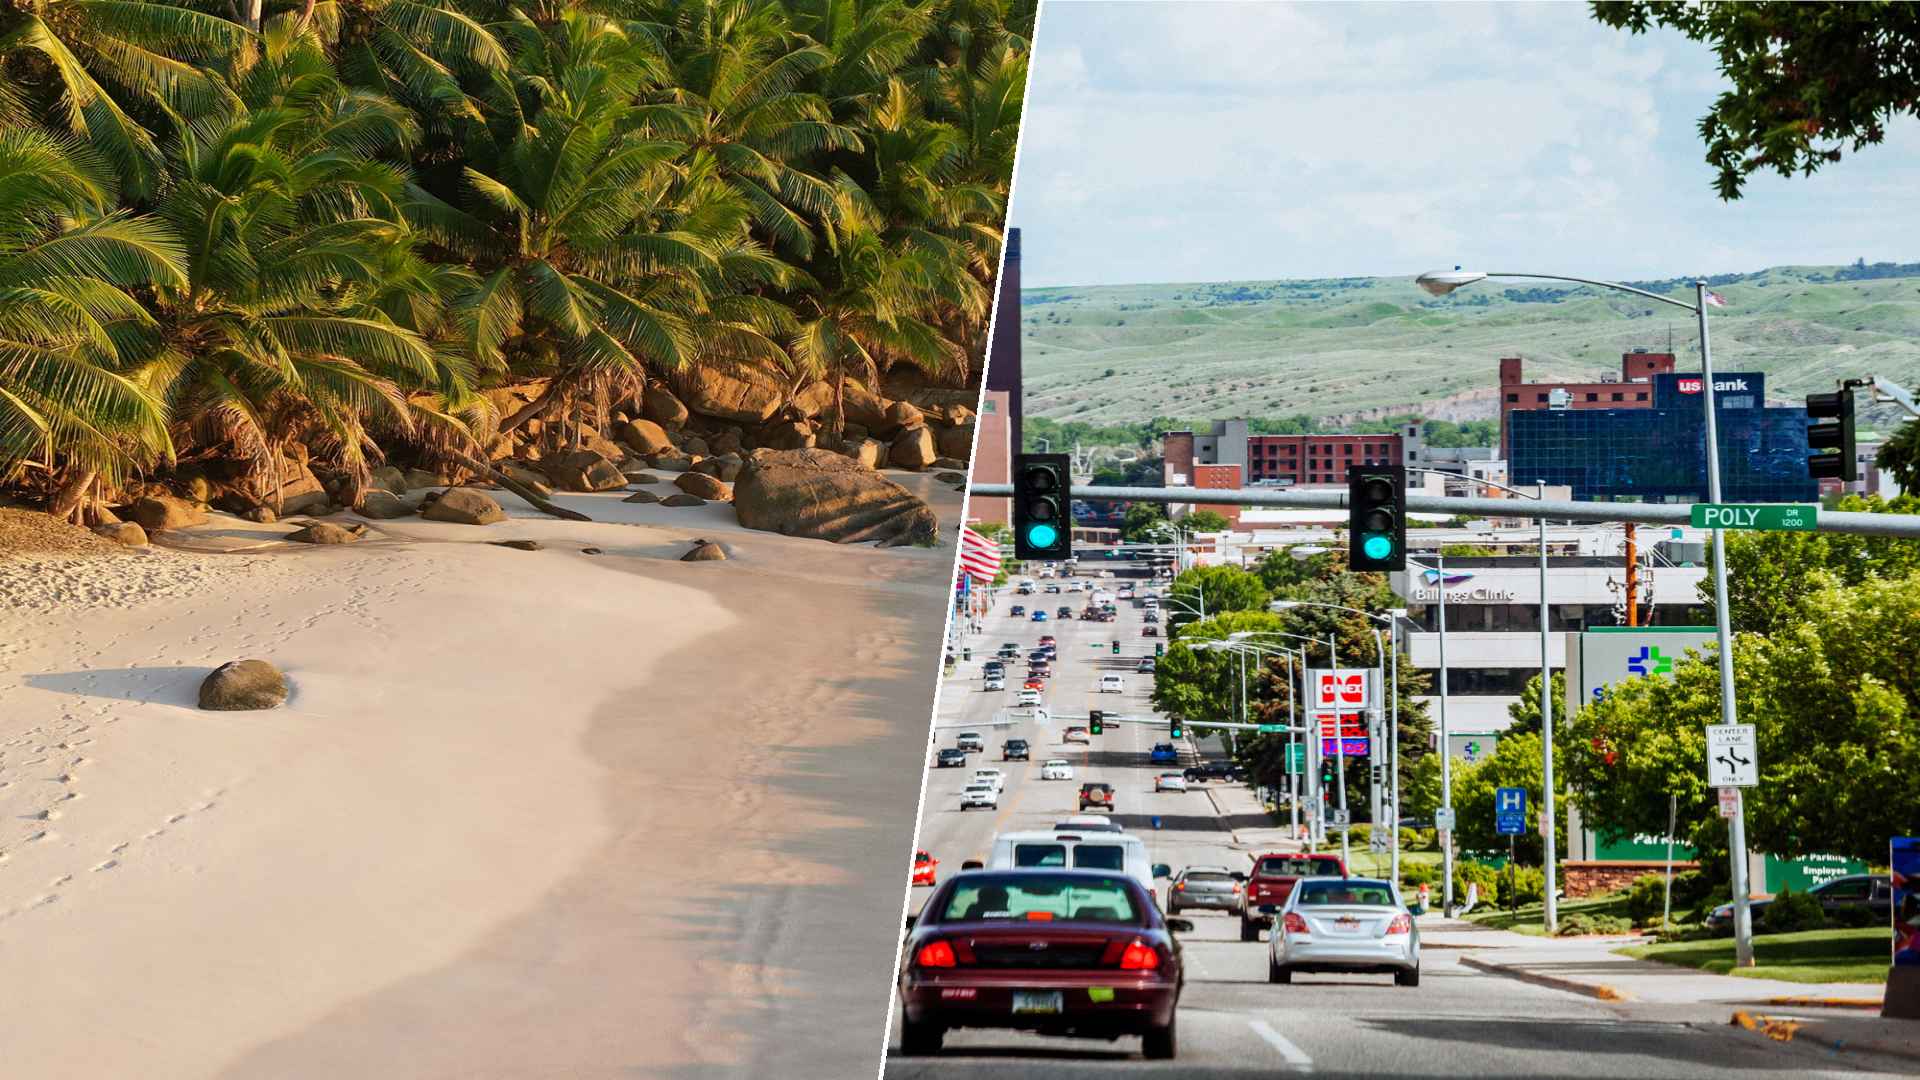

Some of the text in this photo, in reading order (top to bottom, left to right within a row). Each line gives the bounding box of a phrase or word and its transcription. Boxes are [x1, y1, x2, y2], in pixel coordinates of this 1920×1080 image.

[1705, 508, 1760, 526] POLY
[1786, 509, 1798, 517] DR
[1782, 518, 1803, 527] 1200
[1415, 588, 1515, 603] Billngs Clinic
[1503, 792, 1520, 809] H
[1809, 852, 1847, 863] Parking
[1803, 865, 1847, 876] Employee
